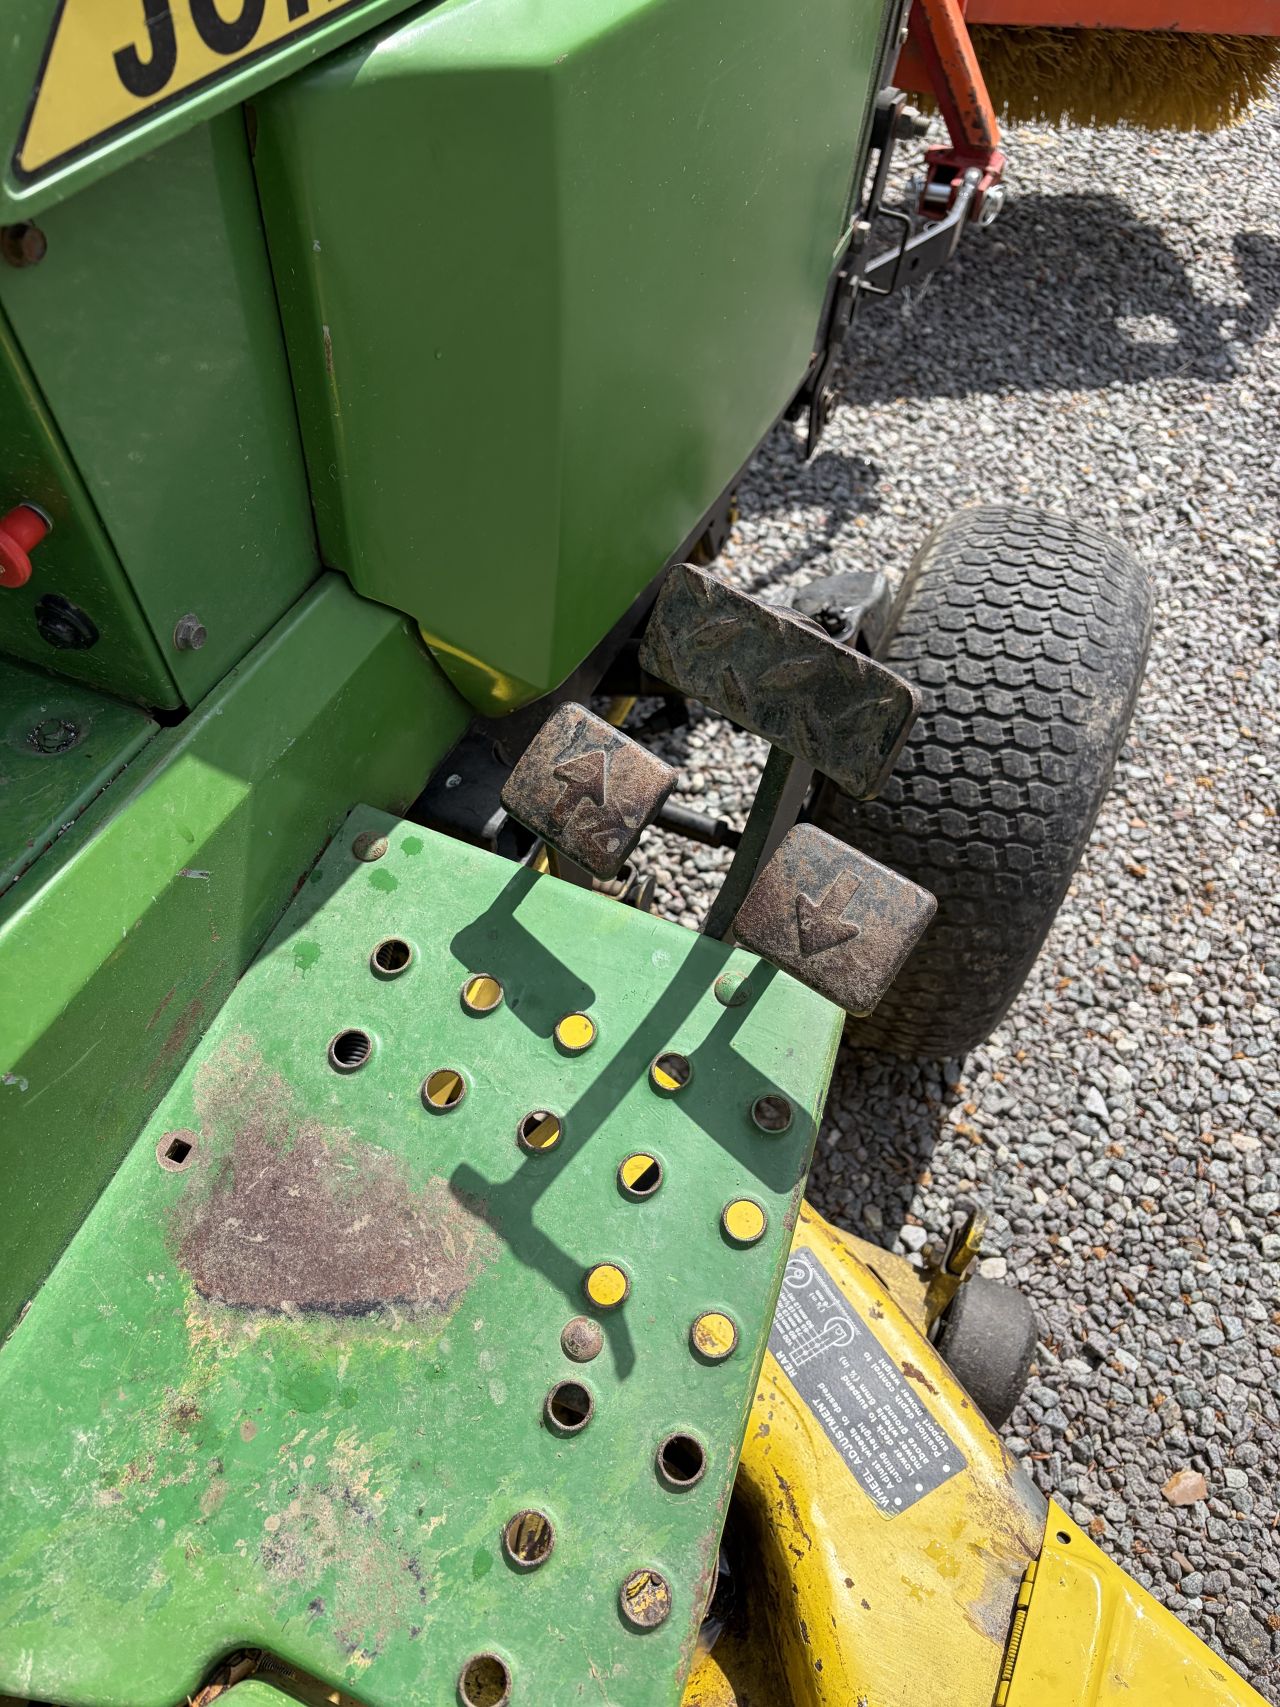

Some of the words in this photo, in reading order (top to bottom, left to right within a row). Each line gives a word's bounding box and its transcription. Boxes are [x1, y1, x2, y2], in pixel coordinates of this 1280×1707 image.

[113, 0, 336, 98] JO
[775, 1350, 798, 1378] REAR
[863, 1351, 872, 1362] to
[870, 1362, 895, 1392] control
[877, 1358, 901, 1388] weight
[816, 1382, 842, 1413] desired
[840, 1374, 869, 1410] suspend
[894, 1394, 915, 1419] depth
[900, 1388, 923, 1416] mower
[812, 1398, 863, 1464] ADJUSTMENT
[841, 1415, 850, 1426] to
[868, 1412, 877, 1423] to
[875, 1407, 899, 1438] wheels
[882, 1403, 909, 1435] ground
[849, 1427, 872, 1458] wheels
[857, 1421, 880, 1451] height
[876, 1423, 894, 1446] deck
[914, 1421, 942, 1458] Position
[921, 1418, 949, 1452] support
[893, 1448, 915, 1476] Lower
[898, 1440, 922, 1470] mower
[907, 1437, 930, 1464] above
[871, 1459, 895, 1489] Adjust
[878, 1451, 902, 1483] cutting
[862, 1467, 889, 1507] WHEEL
